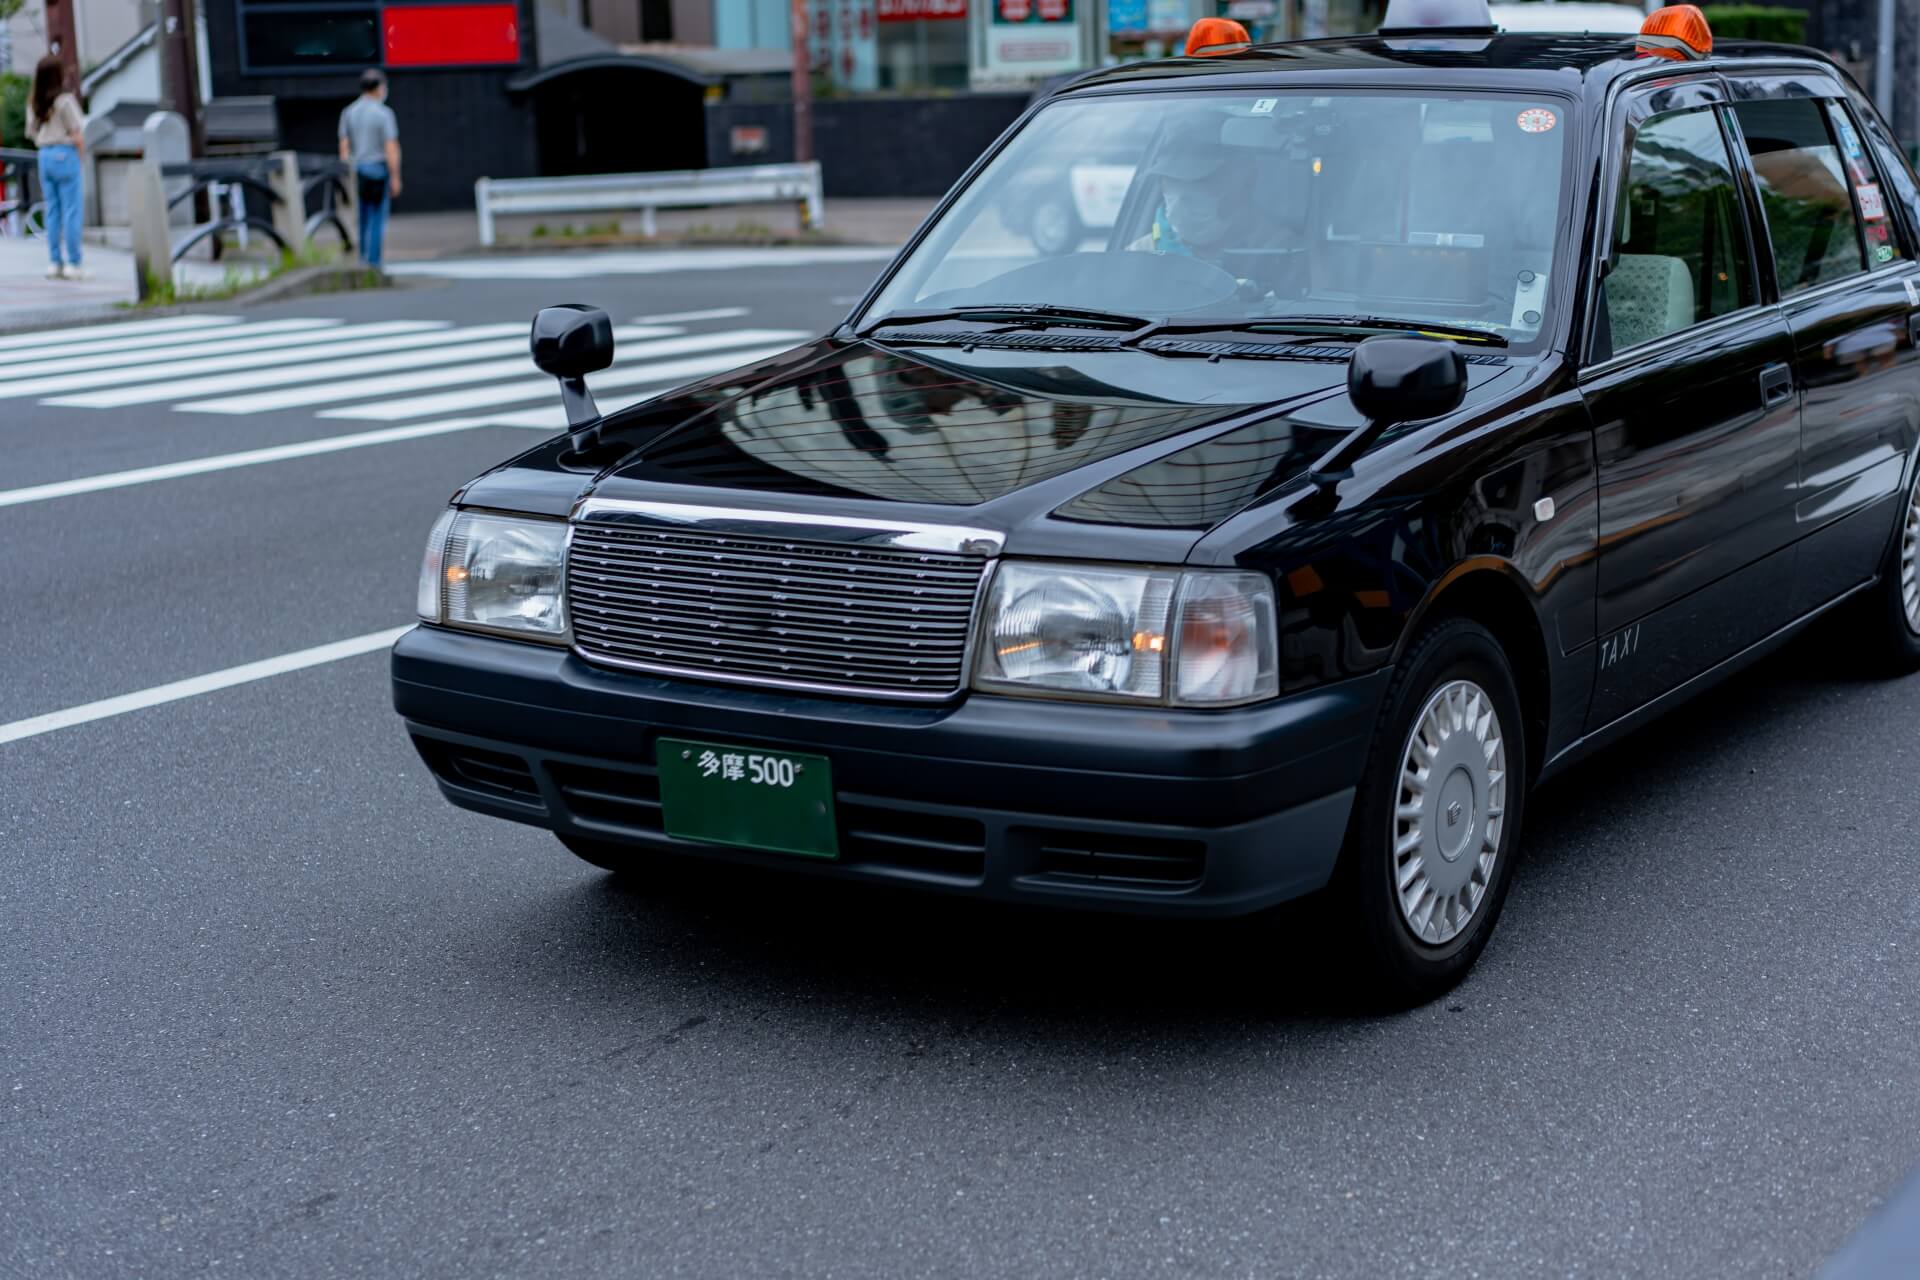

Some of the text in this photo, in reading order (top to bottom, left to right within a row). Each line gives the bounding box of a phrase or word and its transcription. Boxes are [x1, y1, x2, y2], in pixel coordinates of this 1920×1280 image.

[1601, 623, 1640, 670] TAXI
[697, 750, 795, 788] 多摩 500
